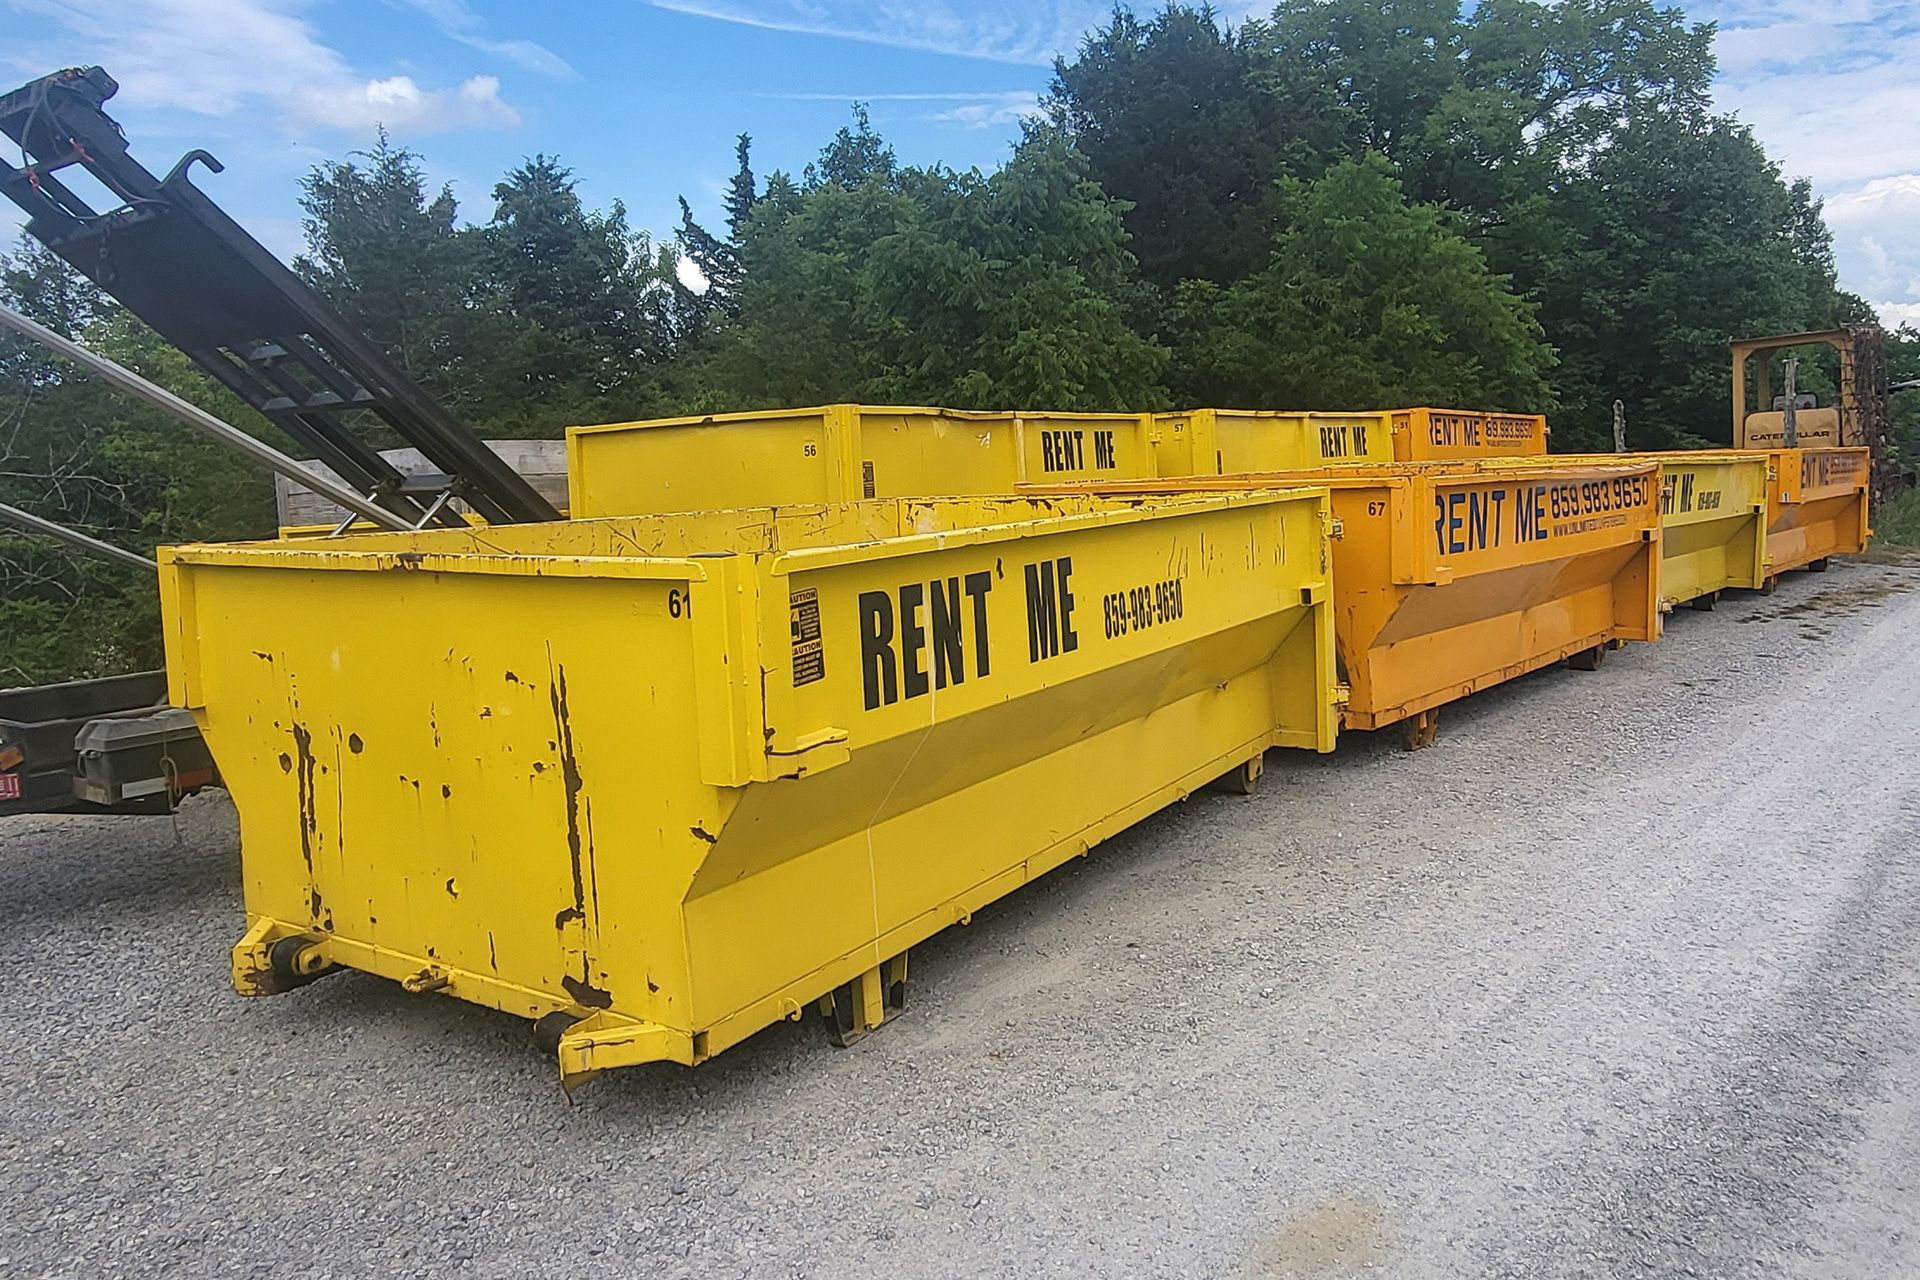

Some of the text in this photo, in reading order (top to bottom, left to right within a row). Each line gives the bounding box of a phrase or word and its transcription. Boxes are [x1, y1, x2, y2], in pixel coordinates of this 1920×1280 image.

[1174, 423, 1184, 432] 57
[1463, 419, 1480, 446] ME
[1750, 431, 1830, 441] CATERILLAR
[804, 445, 816, 457] 56
[1041, 431, 1115, 472] RENT ME
[1320, 426, 1367, 458] RENT ME
[1680, 473, 1694, 513] ME
[1368, 502, 1385, 516] 67
[1515, 486, 1548, 544] ME
[1550, 476, 1649, 519] 859.983.9650
[668, 589, 691, 619] 61
[790, 591, 816, 603] AUTION
[858, 557, 1182, 711] RENT ME 859-983-9650
[792, 642, 821, 656] AUTION
